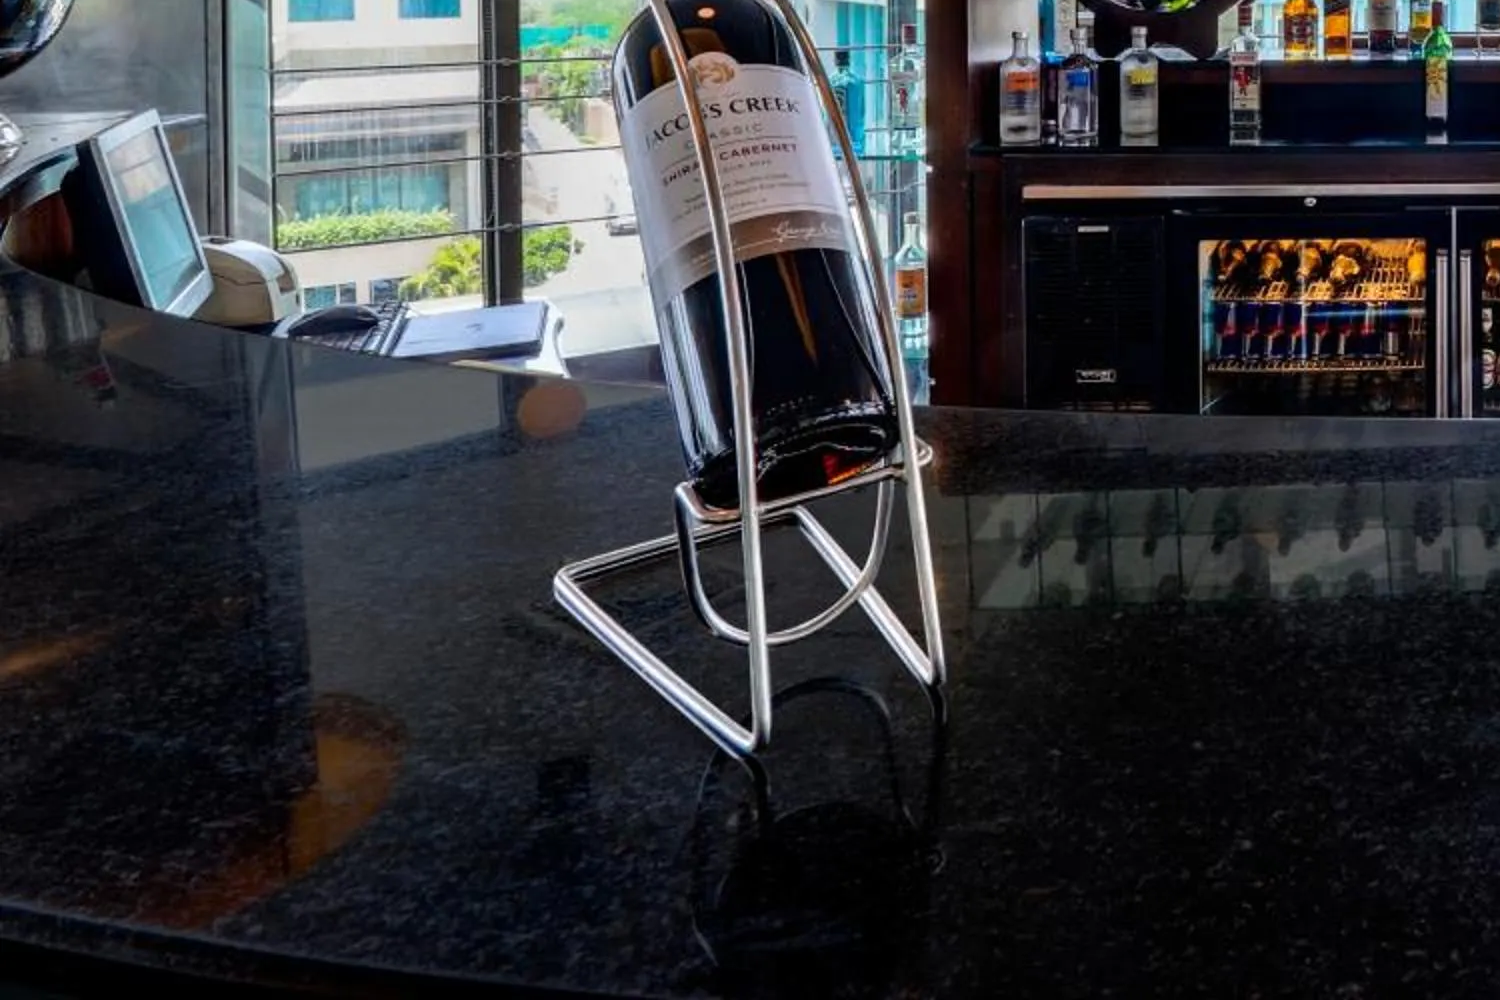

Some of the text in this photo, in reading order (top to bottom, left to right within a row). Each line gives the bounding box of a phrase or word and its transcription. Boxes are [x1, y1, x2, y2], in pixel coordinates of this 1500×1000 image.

[729, 96, 801, 115] CREEK
[685, 122, 764, 149] CASSIC
[719, 143, 797, 160] CABERNET
